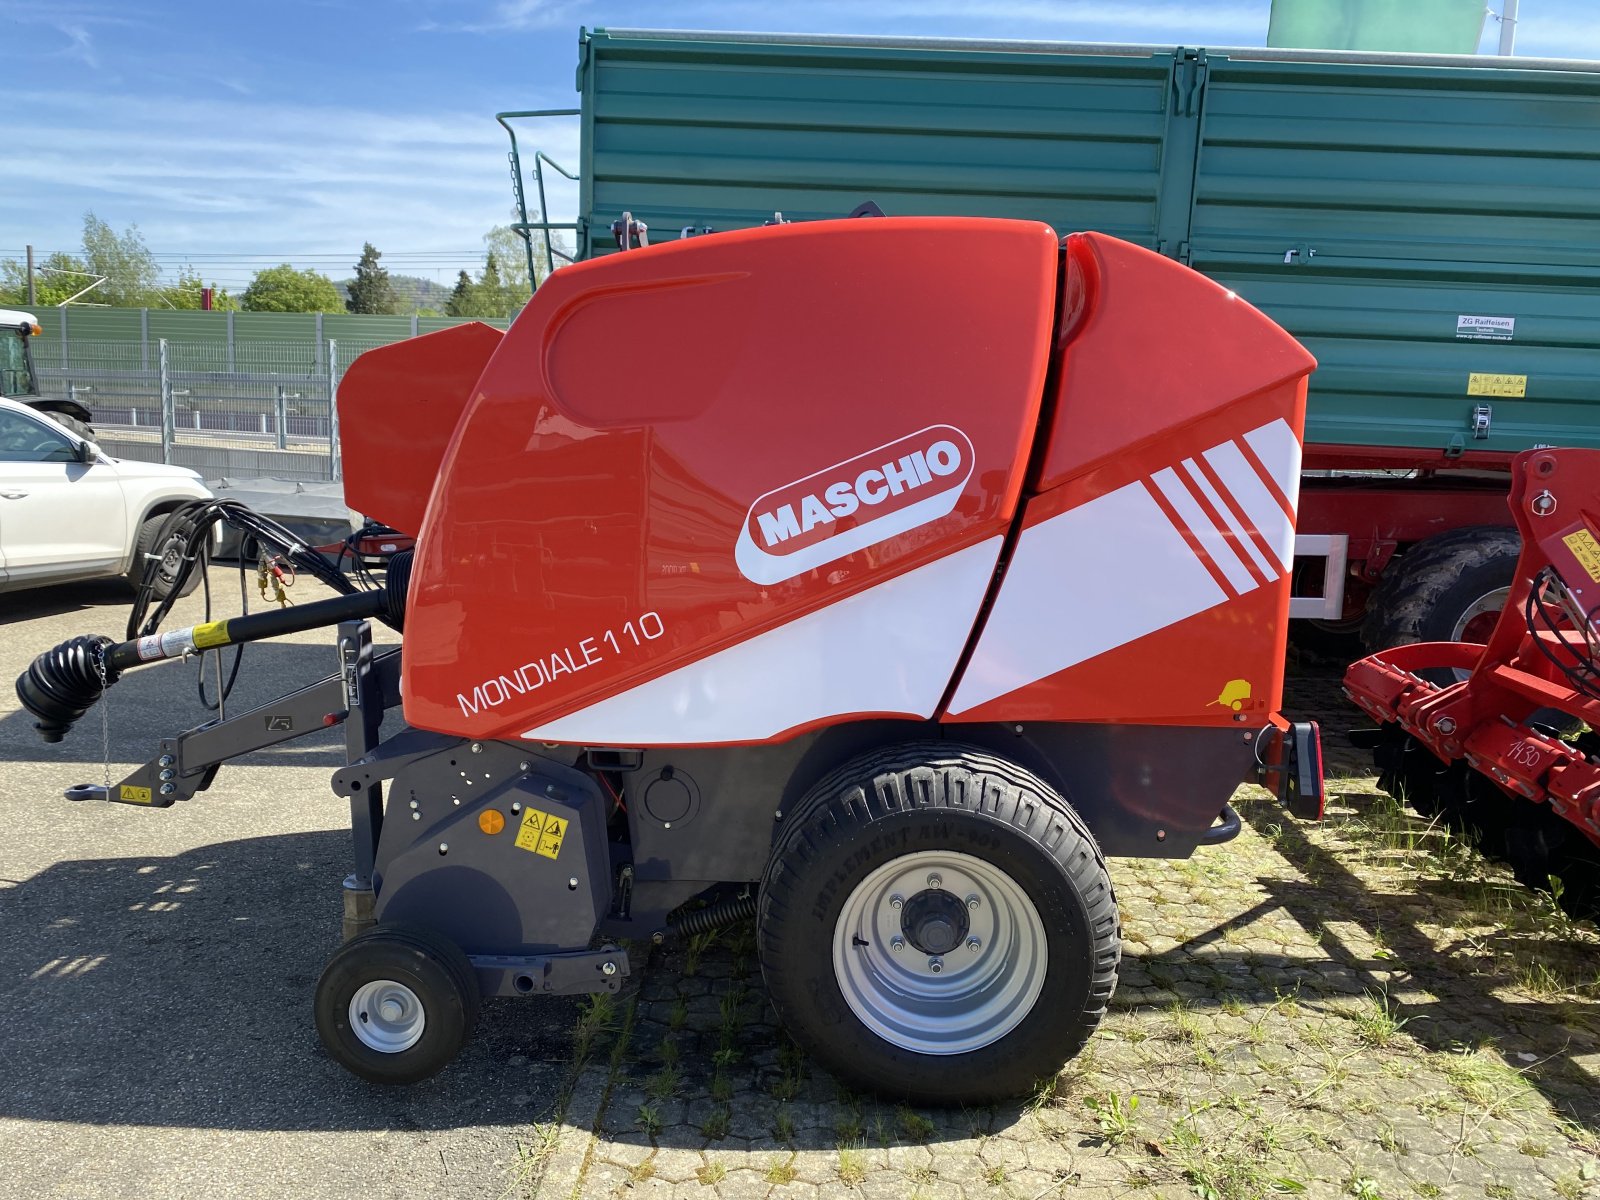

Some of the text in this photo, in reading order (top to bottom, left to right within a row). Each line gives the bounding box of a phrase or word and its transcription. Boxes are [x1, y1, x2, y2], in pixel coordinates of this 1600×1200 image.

[1475, 318, 1510, 327] Raiffeisen
[756, 440, 962, 547] MASCHIO
[456, 612, 664, 717] MONDIALE 110
[1507, 741, 1540, 766] 1430
[812, 826, 911, 922] IMPLEMENT
